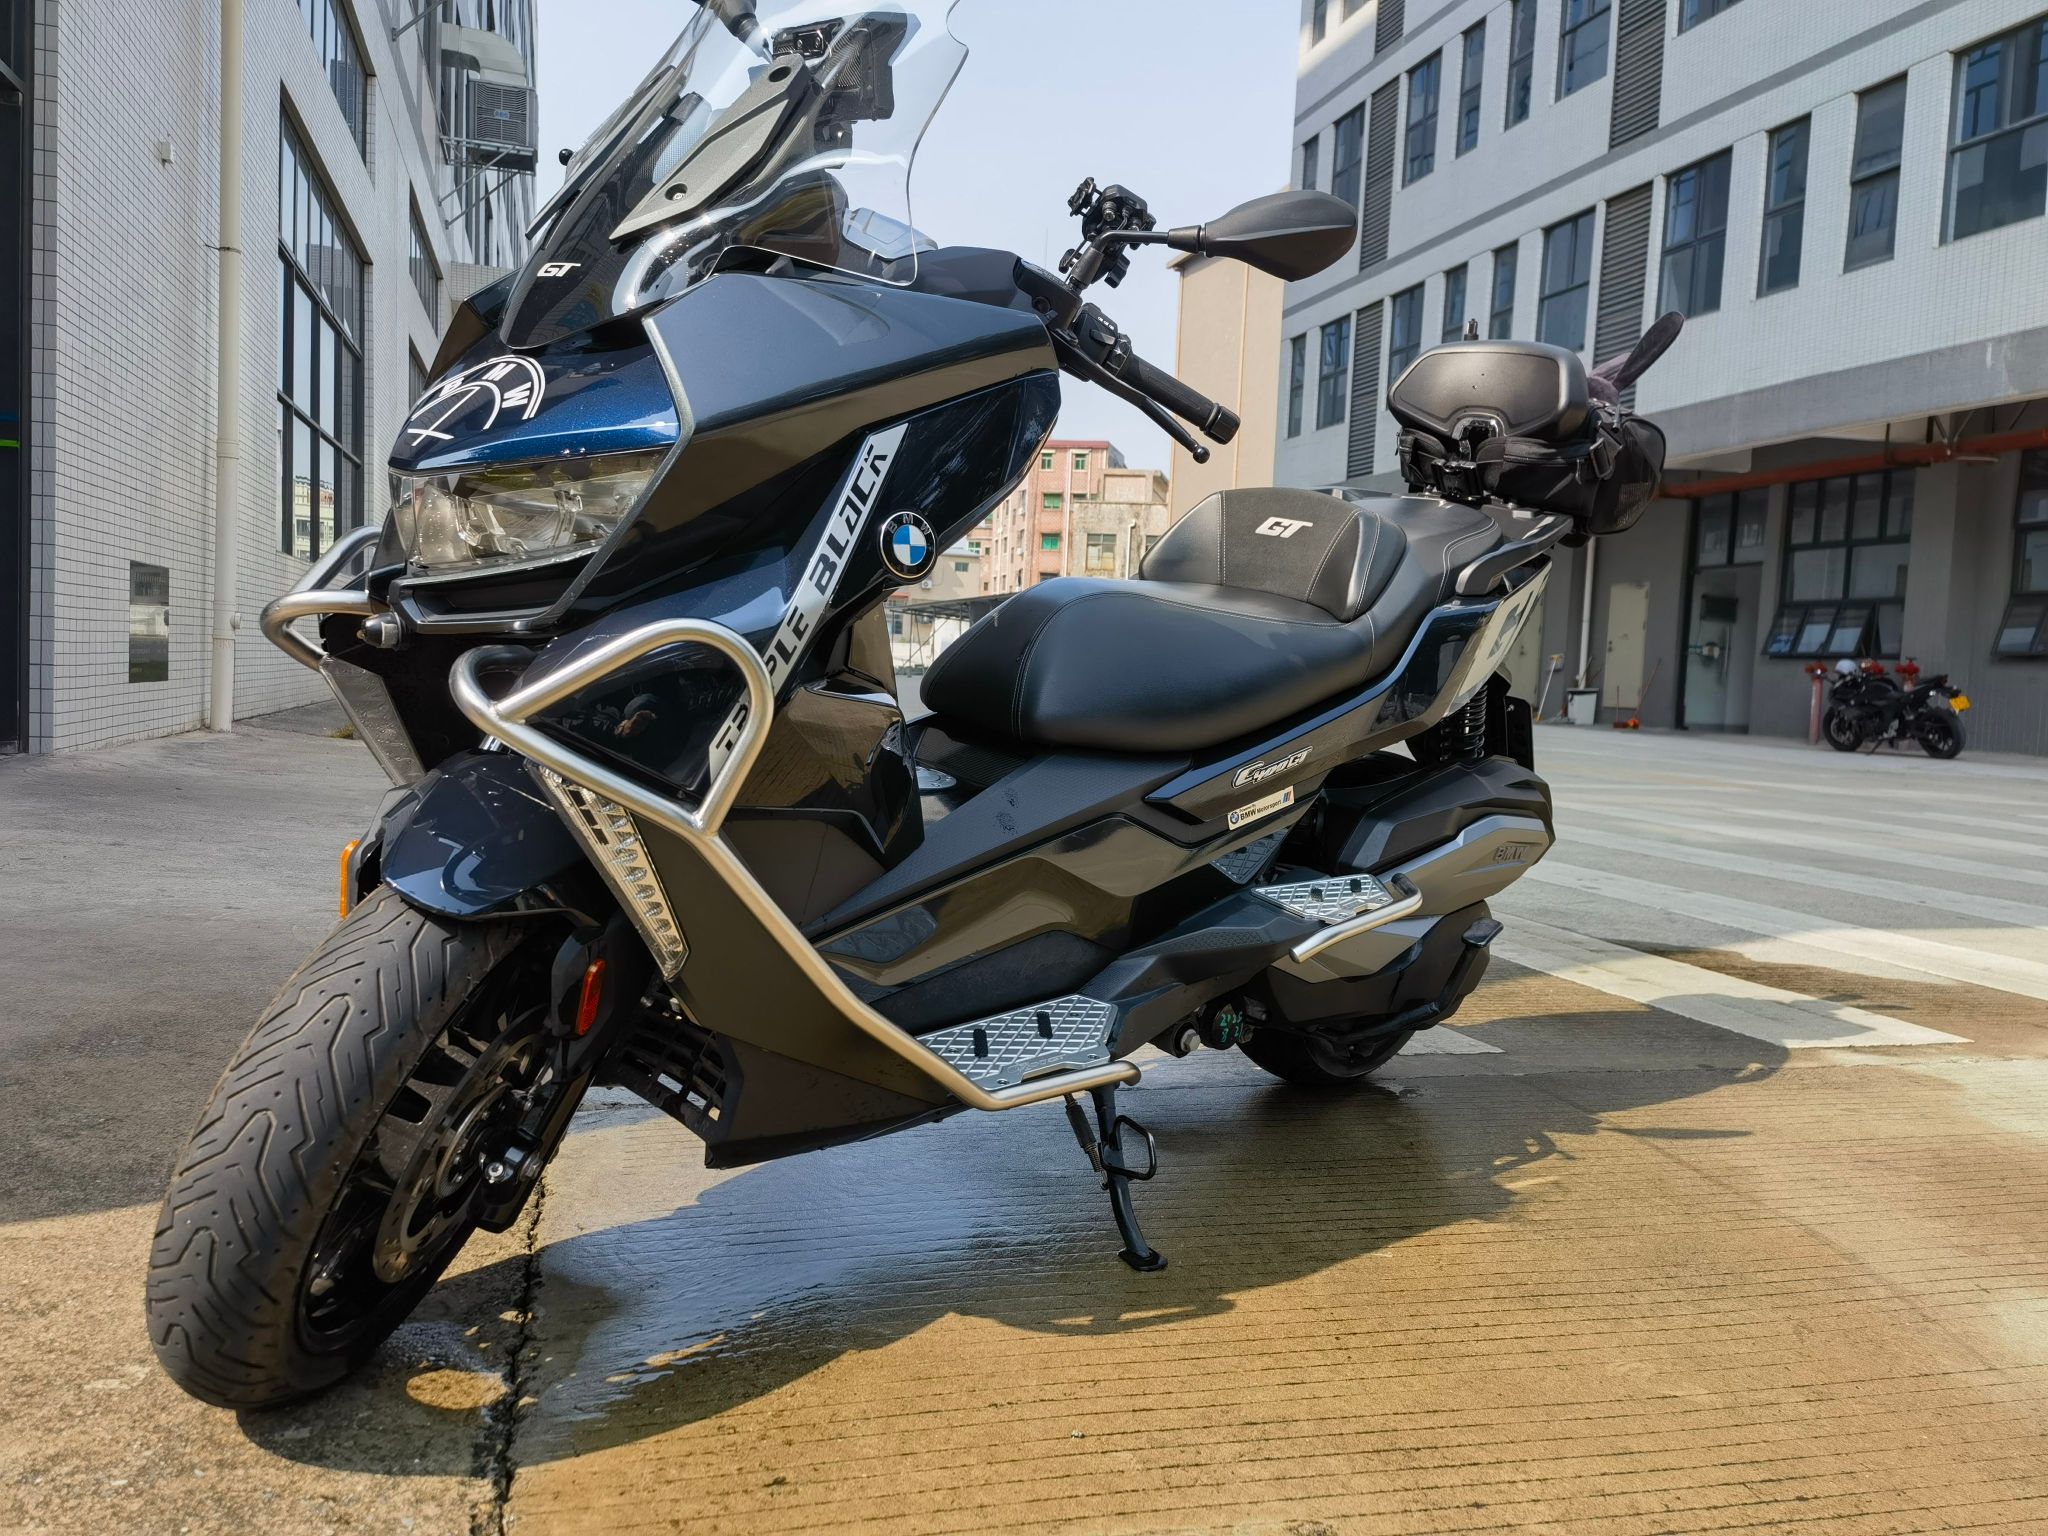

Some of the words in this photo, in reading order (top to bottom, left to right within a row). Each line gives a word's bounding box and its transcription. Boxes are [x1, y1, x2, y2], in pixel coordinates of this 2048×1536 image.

[537, 262, 581, 277] GT
[439, 362, 532, 409] BMW
[809, 444, 888, 597] BLACK
[887, 513, 931, 535] BMW
[1255, 516, 1313, 538] GT
[1240, 808, 1257, 820] BMW
[1257, 800, 1282, 813] Motorsport
